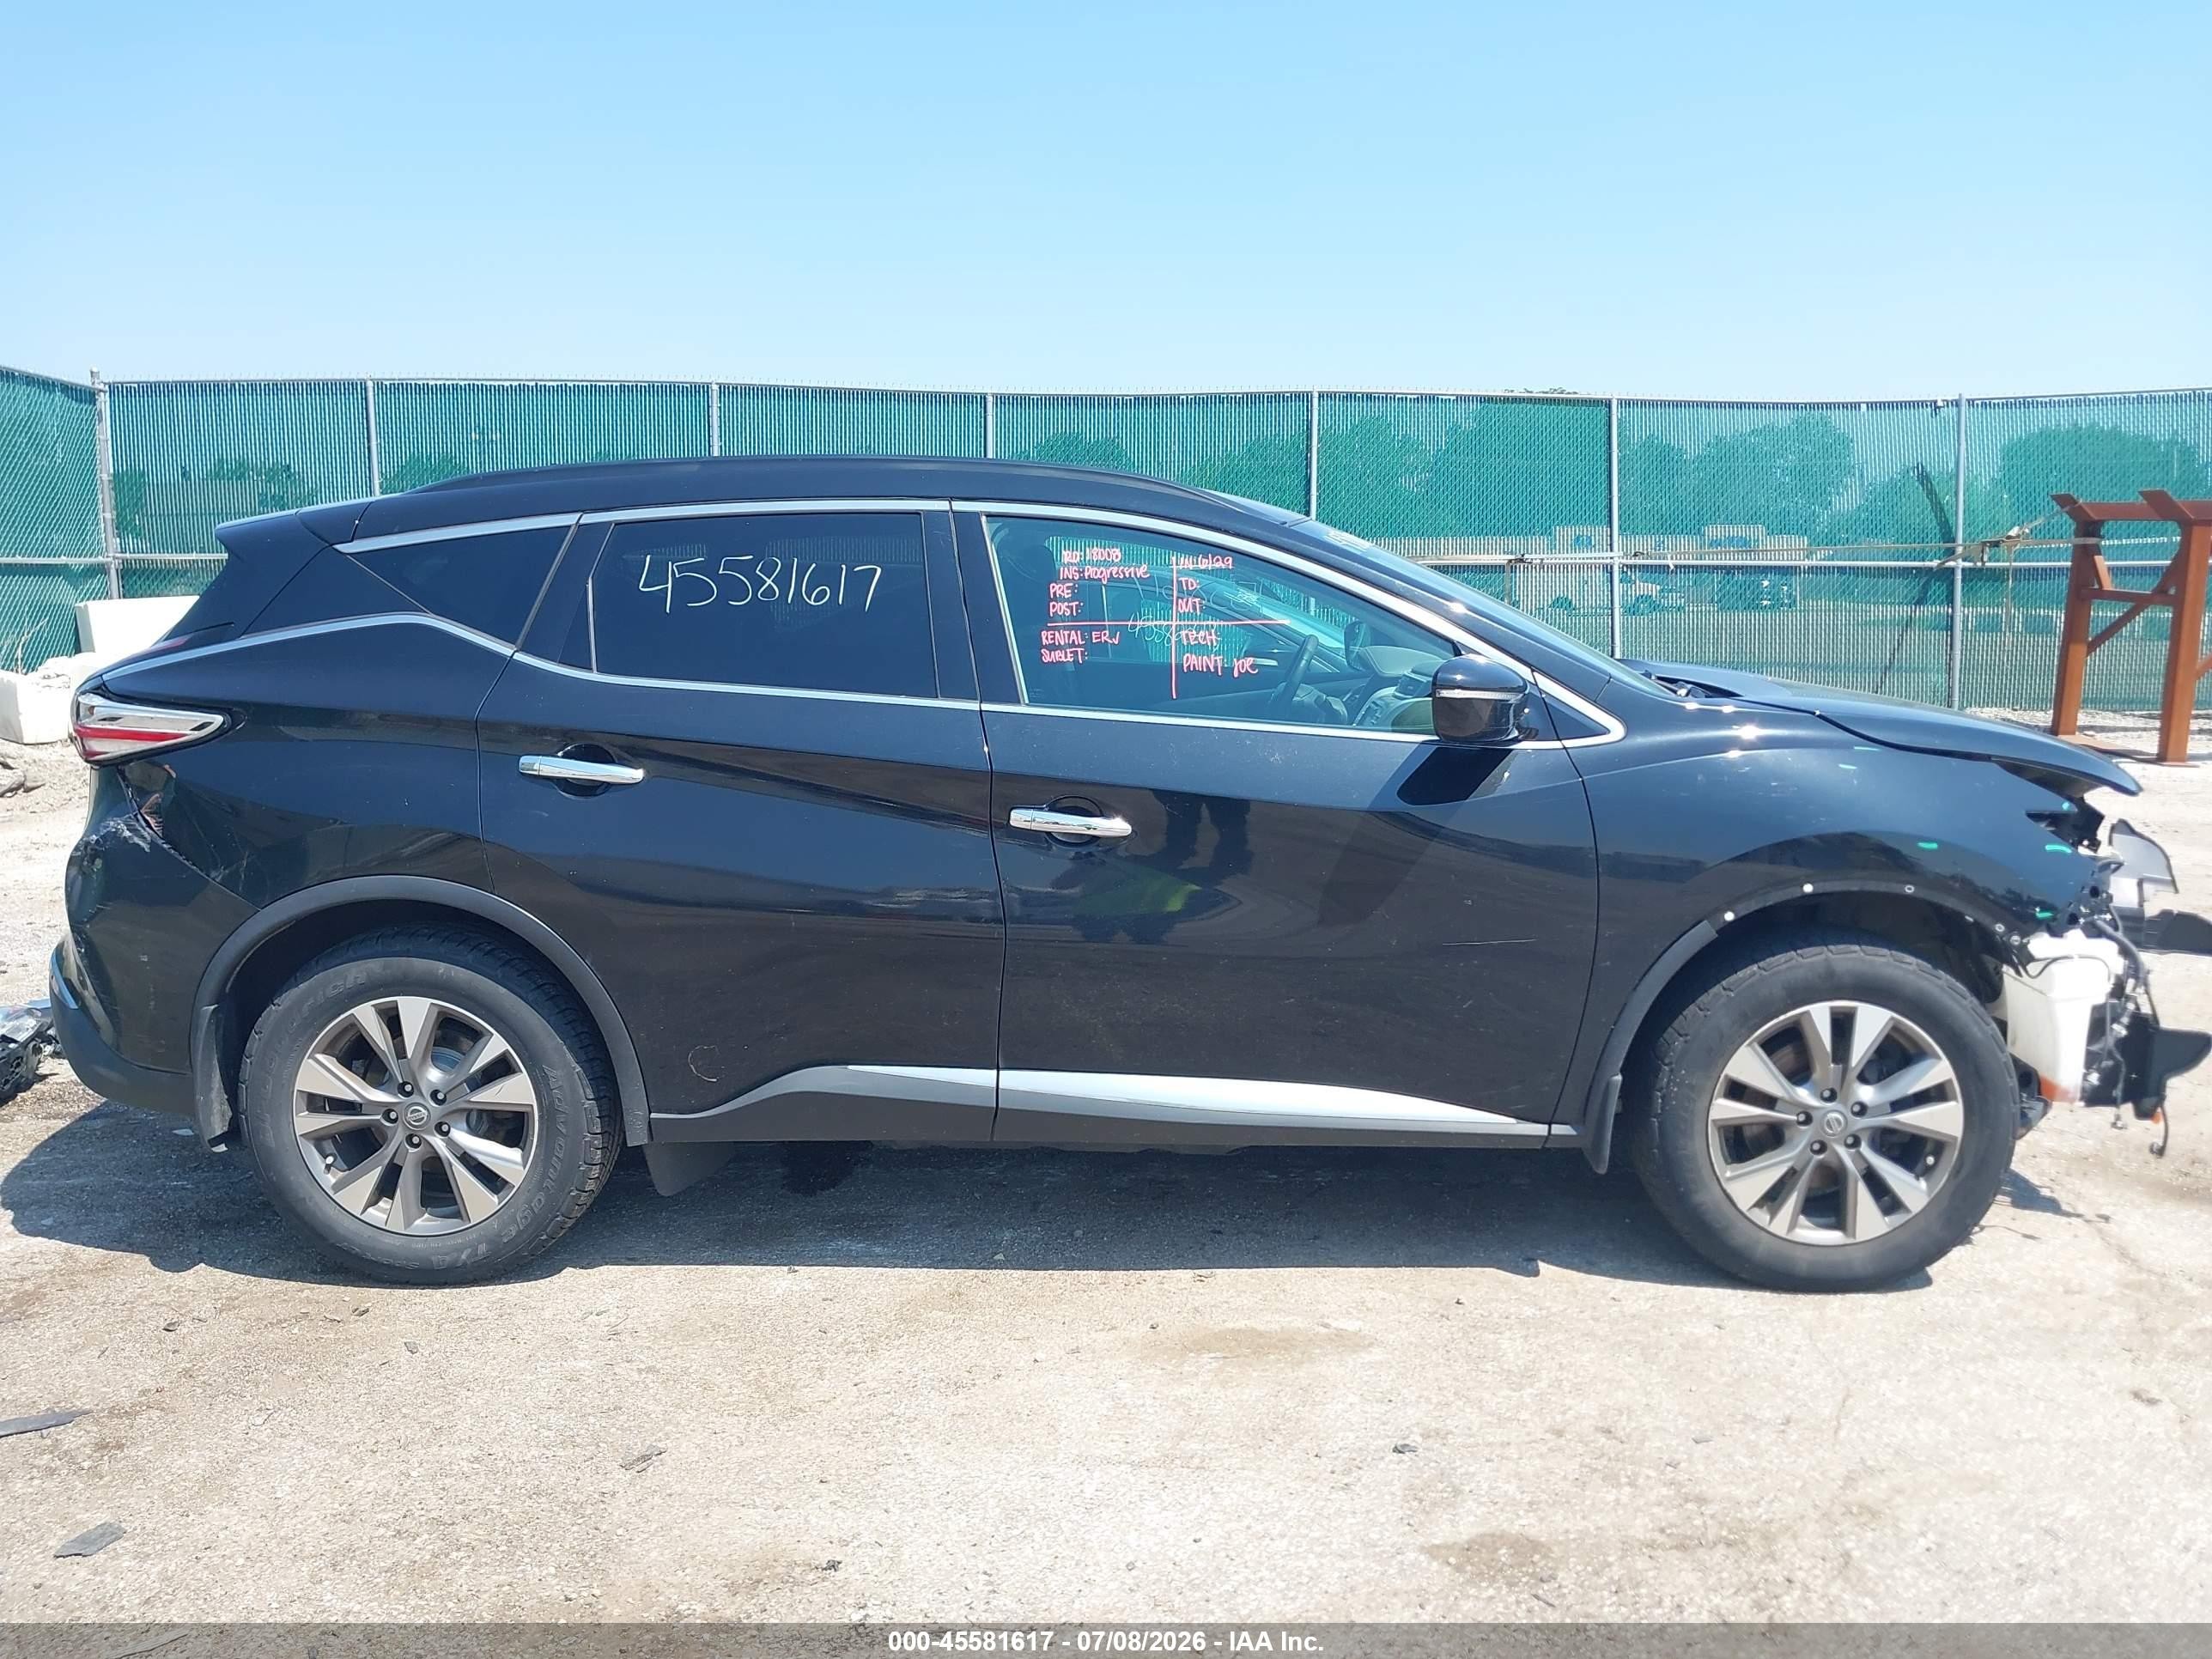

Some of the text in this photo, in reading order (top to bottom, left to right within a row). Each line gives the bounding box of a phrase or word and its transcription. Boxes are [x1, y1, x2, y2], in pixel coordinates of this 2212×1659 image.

[638, 555, 883, 613] 45581617
[1049, 583, 1079, 599] PRE:
[1049, 601, 1083, 617] POST:
[1177, 599, 1206, 615] OUT:
[1041, 629, 1089, 646] RENTAL:
[1040, 648, 1089, 665] SUBLET:
[1182, 653, 1228, 677] PAINT:
